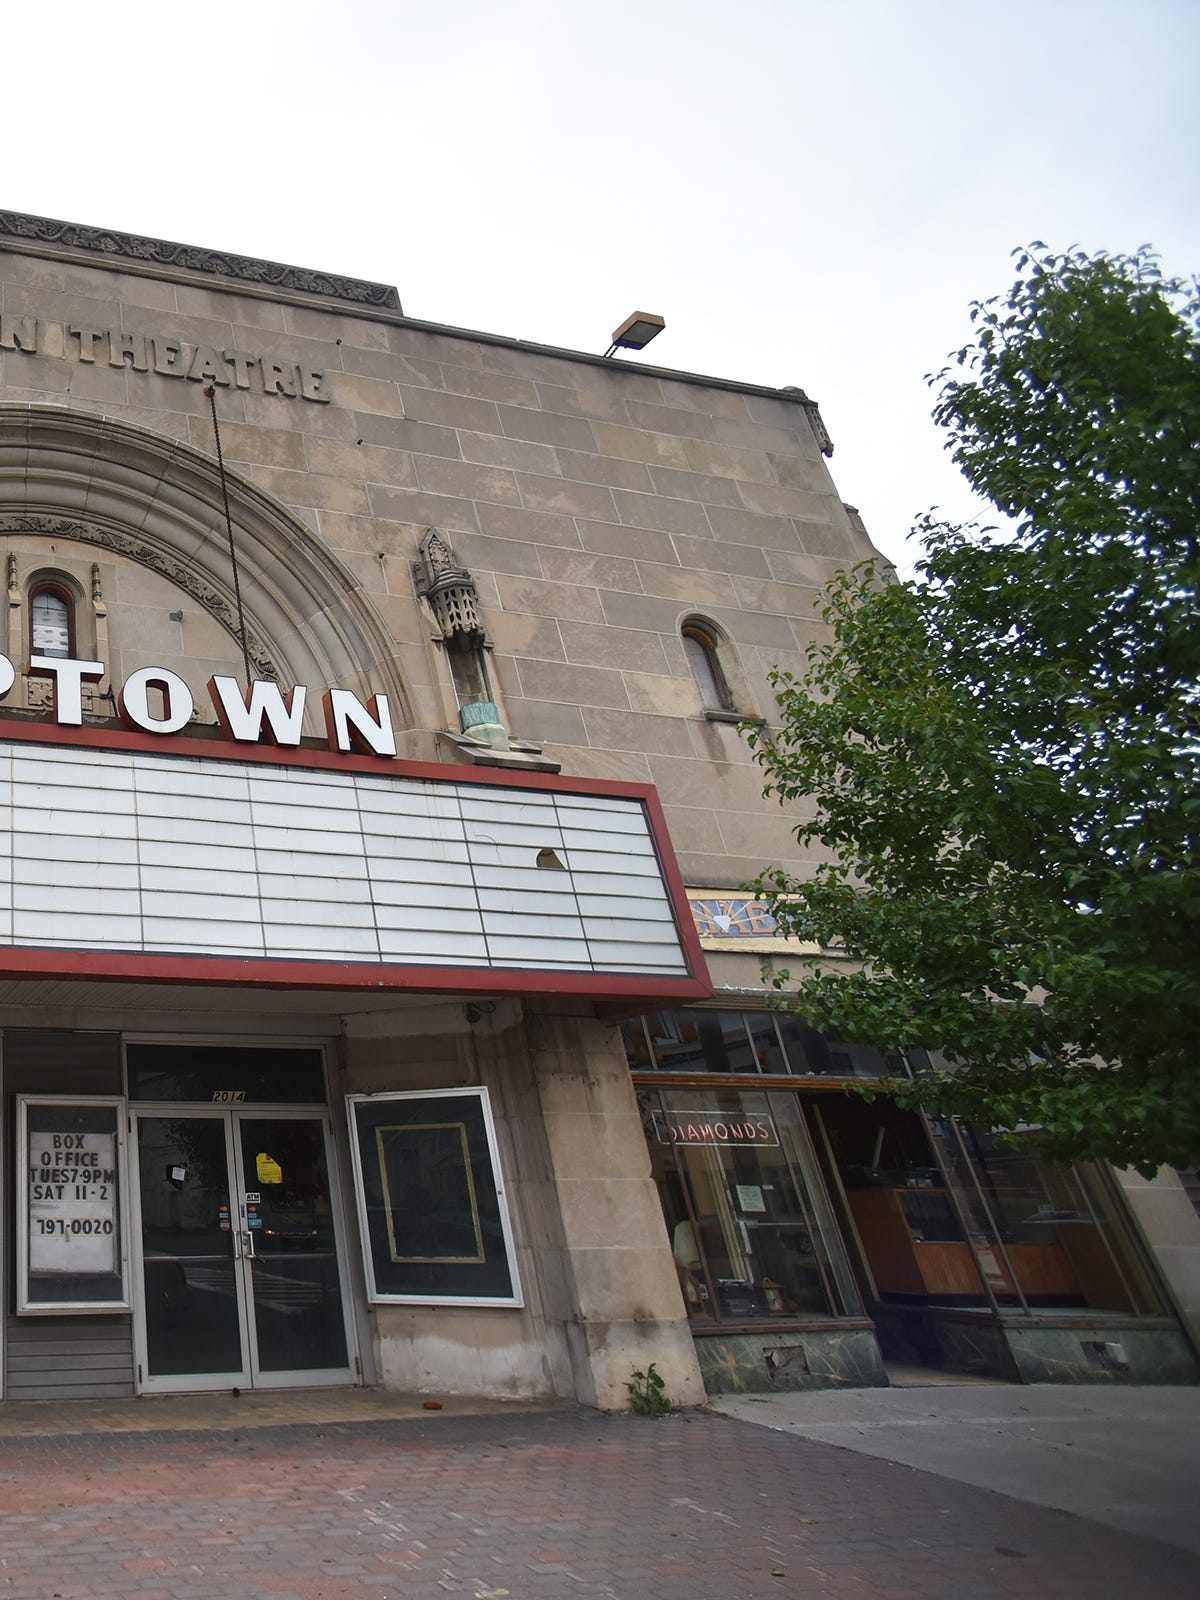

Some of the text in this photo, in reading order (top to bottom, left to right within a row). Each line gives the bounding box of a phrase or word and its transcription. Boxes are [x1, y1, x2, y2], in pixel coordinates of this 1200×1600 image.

[67, 323, 331, 404] THEATRE
[213, 1091, 244, 1102] 2014
[53, 1135, 85, 1149] BOX
[41, 1151, 99, 1167] OFFICE
[33, 1185, 65, 1200] SAT
